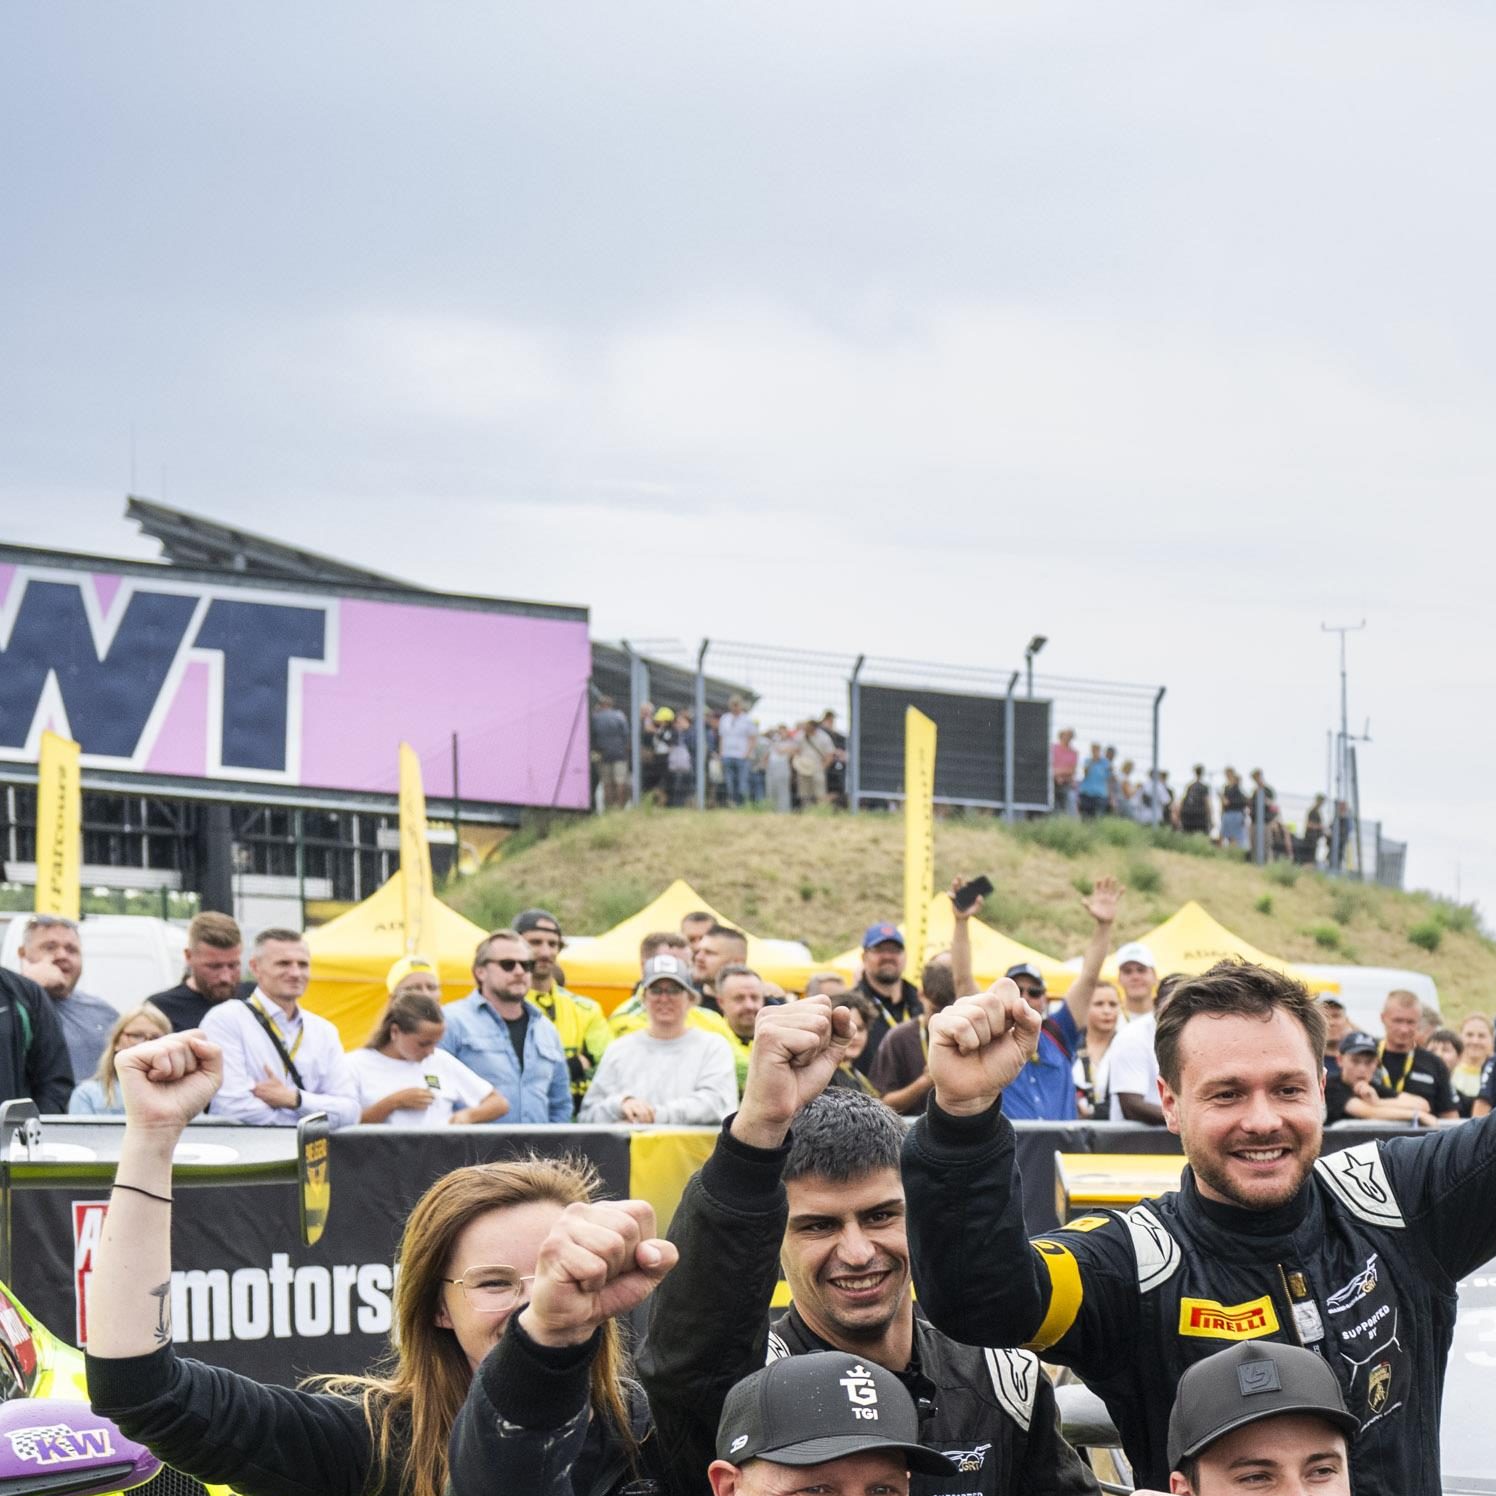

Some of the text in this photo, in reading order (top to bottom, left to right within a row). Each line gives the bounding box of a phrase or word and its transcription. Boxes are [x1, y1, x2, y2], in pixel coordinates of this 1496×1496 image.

[171, 1253, 398, 1343] motors
[1190, 1305, 1267, 1333] PIRELLI
[1341, 1304, 1391, 1341] SUPPORTED
[851, 1406, 879, 1421] TGI
[37, 1429, 109, 1462] KW
